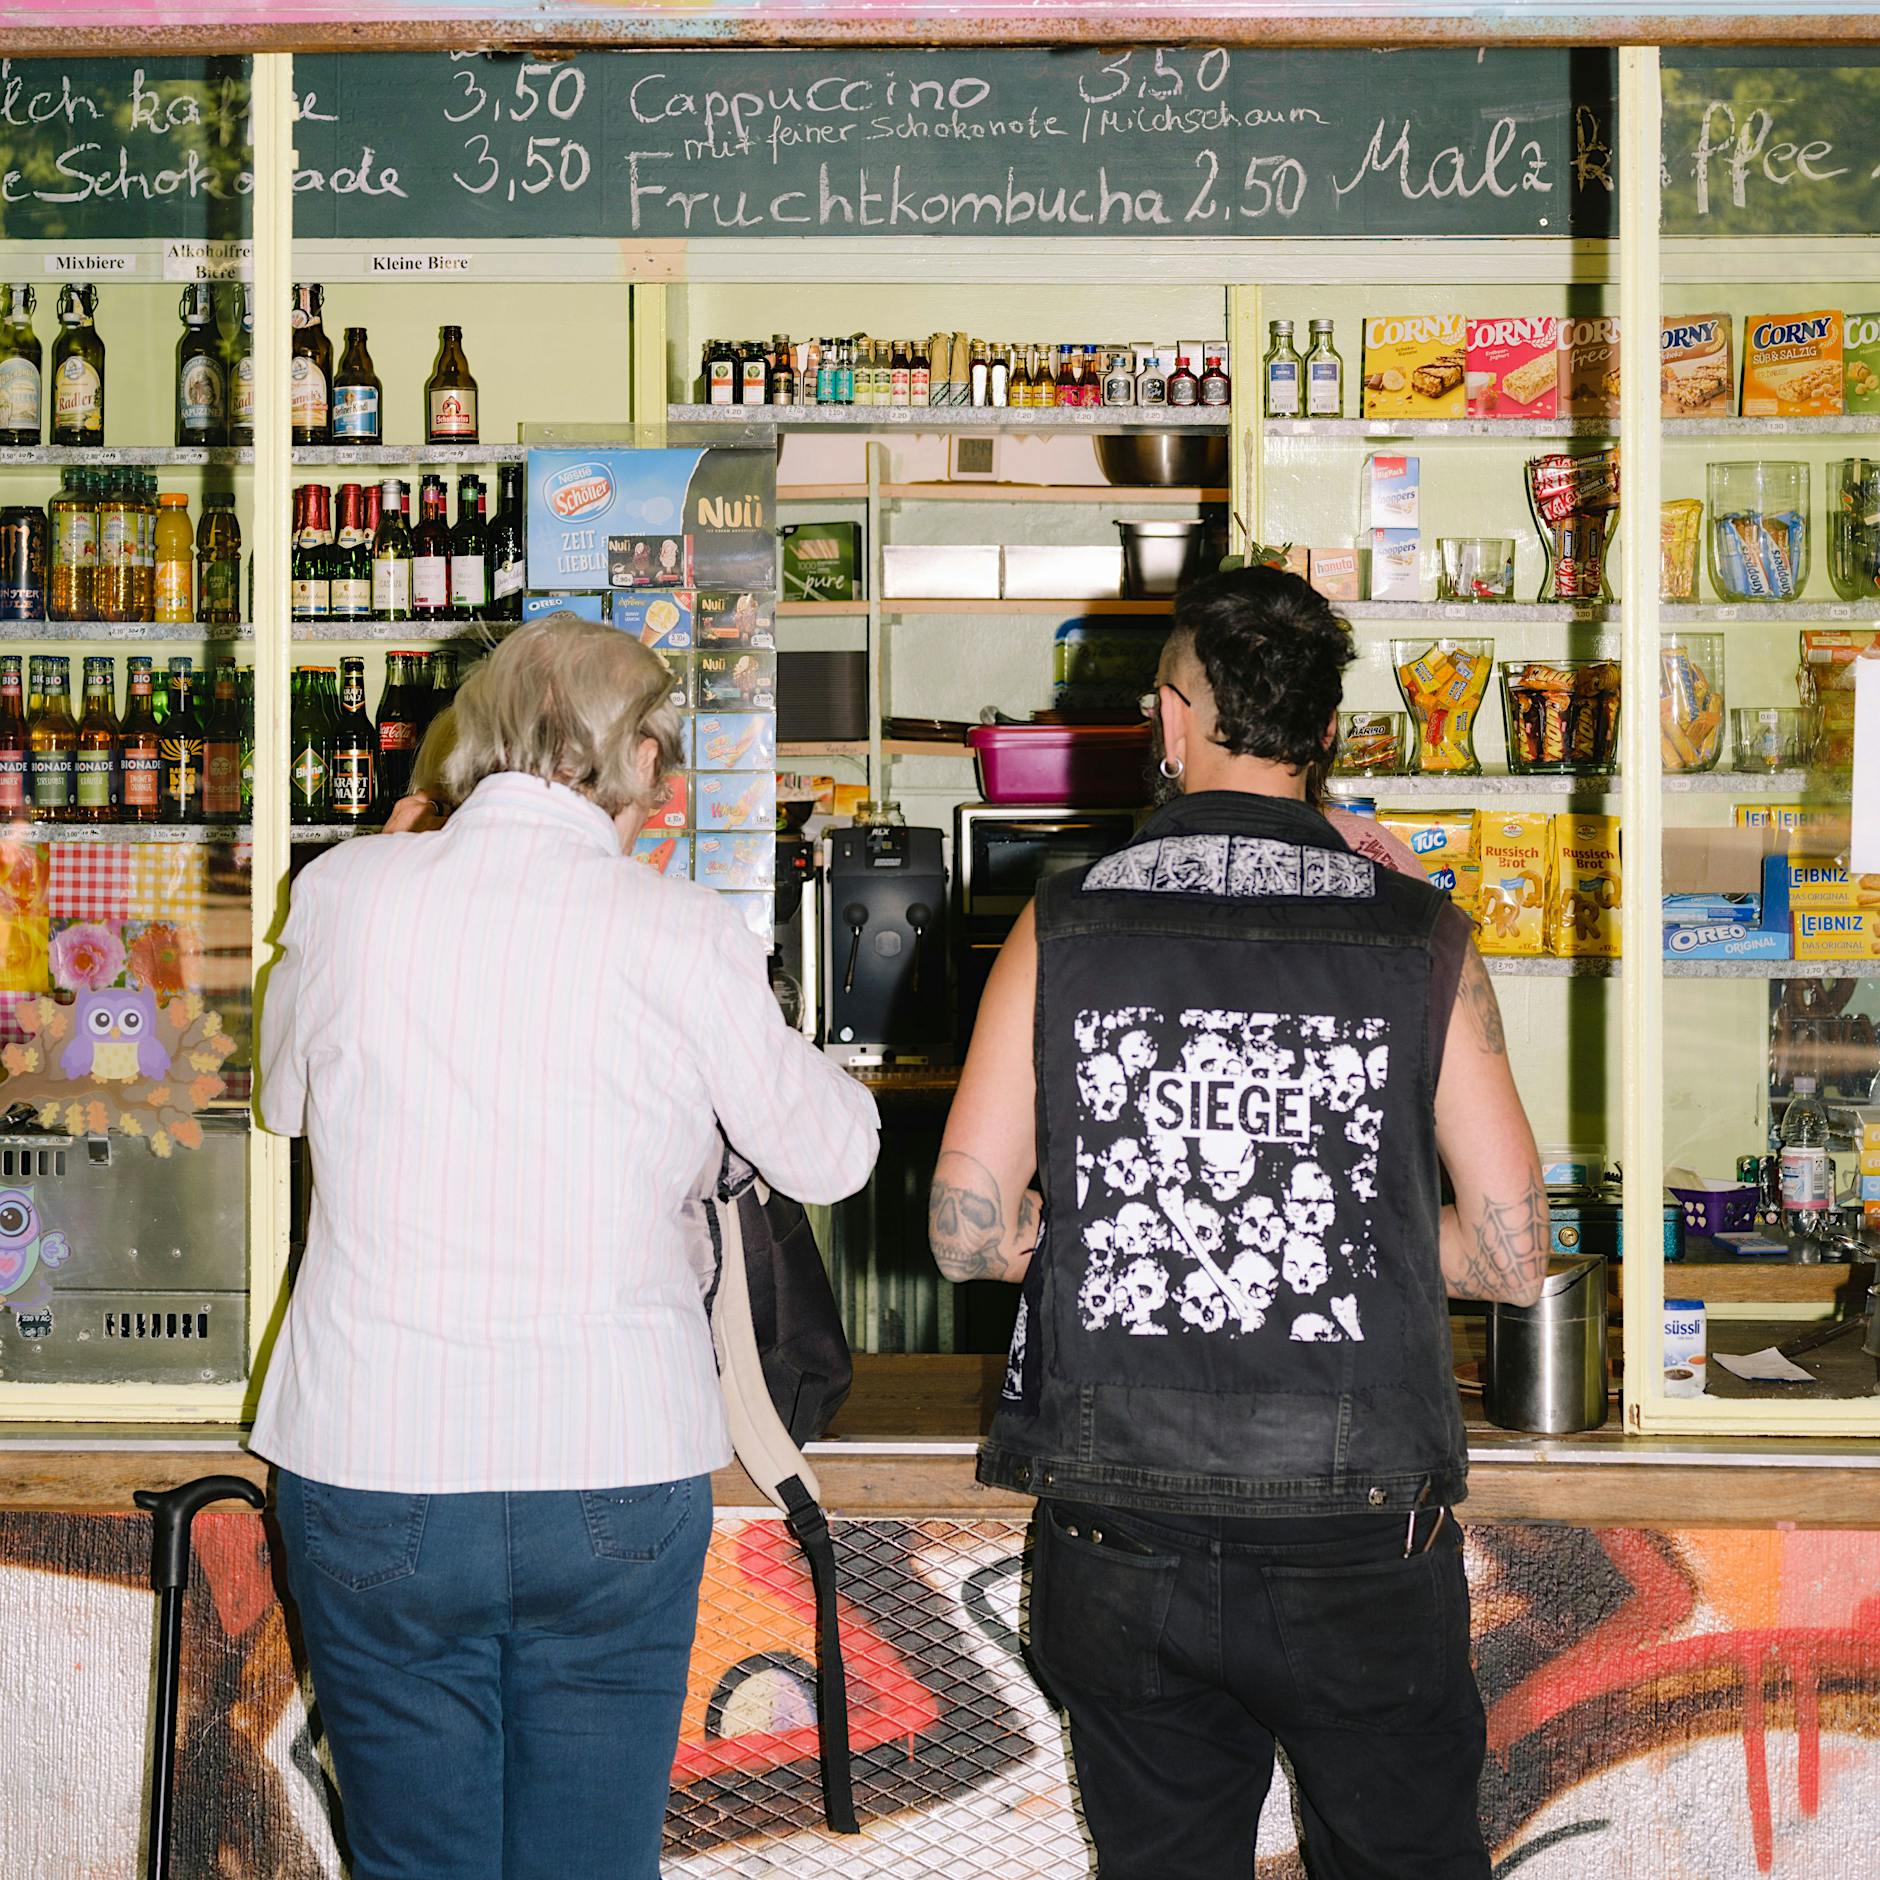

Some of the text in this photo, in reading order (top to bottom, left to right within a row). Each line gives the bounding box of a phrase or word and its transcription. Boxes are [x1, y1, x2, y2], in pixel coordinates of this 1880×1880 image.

[444, 62, 587, 122] 3,50
[630, 73, 991, 146] Cappuccino
[683, 131, 752, 161] mit
[766, 113, 850, 164] feiner
[33, 142, 410, 203] Schokoade
[452, 134, 592, 201] 3,50
[625, 100, 1850, 231] Fruchtkombucha 2,50 Malz kffee
[55, 256, 125, 271] Mixbiere
[195, 265, 237, 279] Biere
[373, 256, 469, 270] Kleine Biere
[1366, 315, 1462, 349] CORNY
[1466, 318, 1552, 352] CORNY
[1661, 320, 1717, 349] ORNY
[1754, 317, 1832, 350] CORNY
[1569, 346, 1614, 373] free
[59, 392, 93, 412] Radler
[555, 480, 609, 516] Schöller
[562, 530, 596, 551] ZEIT
[1316, 557, 1354, 576] hanuta
[1768, 547, 1792, 597] Knoppers
[802, 575, 845, 599] pure
[2, 676, 19, 685] BIO
[45, 676, 62, 685] BIO
[88, 676, 104, 685] BIO
[133, 674, 151, 684] BIO
[121, 759, 161, 771] BIONADE
[871, 828, 890, 836] RLX
[1414, 830, 1444, 853] TUC
[1485, 846, 1539, 859] Russisch
[1562, 847, 1615, 860] Russisch
[1498, 857, 1526, 869] Brot
[1576, 858, 1605, 870] Brot
[1789, 865, 1849, 888] LEIBNIZ
[1808, 892, 1850, 900] ORIGINAL
[1802, 914, 1863, 937] LEIBNIZ
[1669, 924, 1747, 953] OREO
[1725, 936, 1776, 955] ORIGINAL
[1801, 941, 1864, 950] DAS ORIGINAL
[1154, 1078, 1305, 1140] SIEGE
[1664, 1319, 1702, 1337] süssli
